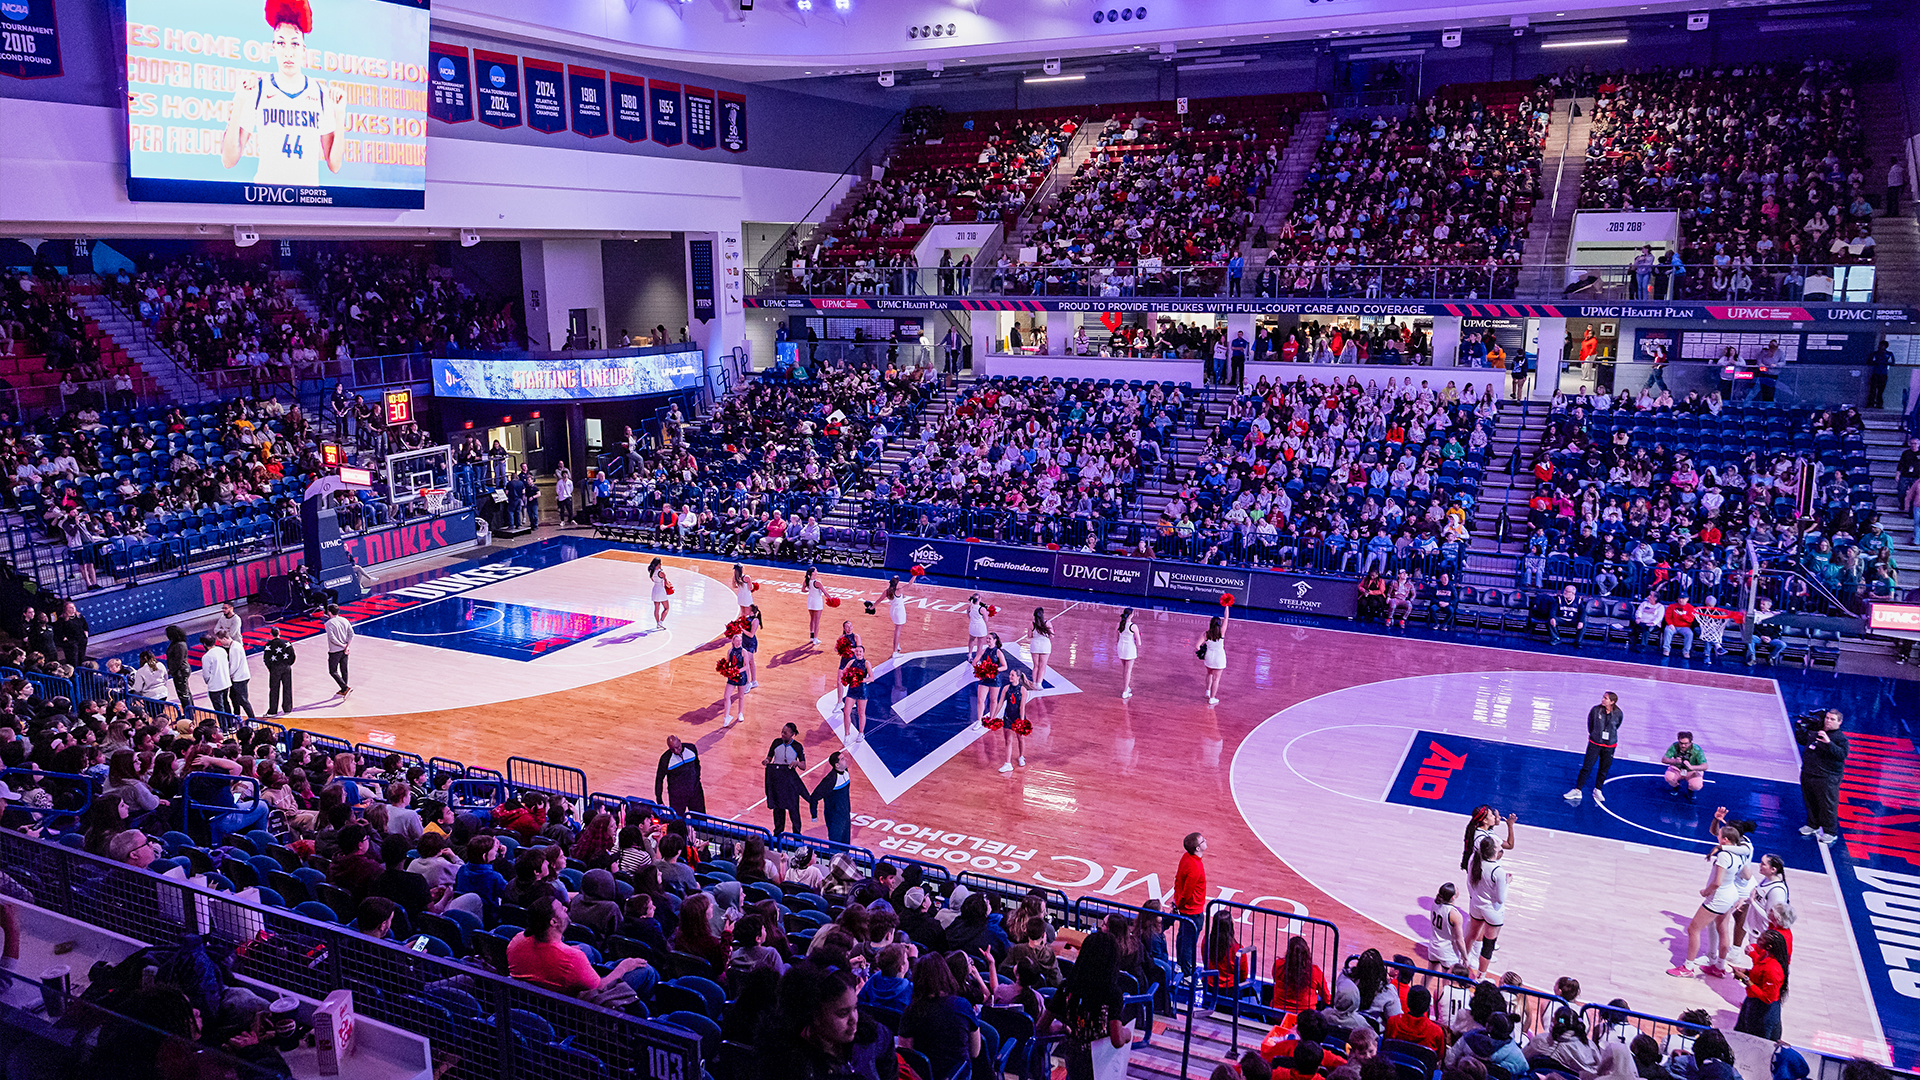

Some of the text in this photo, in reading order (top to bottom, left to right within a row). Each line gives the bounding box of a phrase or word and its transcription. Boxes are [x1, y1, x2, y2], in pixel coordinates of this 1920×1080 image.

[1, 2, 29, 15] NCAA
[1, 22, 54, 35] TOURNAMENT
[2, 31, 37, 54] 2016
[24, 56, 52, 65] ROUND
[164, 27, 242, 60] HOME
[324, 50, 390, 79] DUKES
[535, 80, 556, 98] 2024
[581, 86, 597, 104] 1981
[490, 95, 510, 111] 2024
[621, 93, 638, 110] 1980
[659, 98, 674, 114] 1955
[344, 112, 391, 136] UKES
[281, 134, 303, 159] 44
[244, 186, 295, 203] UPMC
[300, 189, 327, 197] SPORTS
[300, 196, 333, 205] MEDICINE
[1609, 221, 1642, 232] 209 208
[74, 245, 89, 257] 214
[763, 299, 787, 308] UPMC
[822, 300, 847, 309] UPMC
[876, 300, 948, 310] UPMC HEALTH PLAN
[1058, 302, 1427, 315] PROUD TO PROVIDE THE DUKES WITH FULL-COURT CARE AND COVERAGE.
[1580, 306, 1694, 318] UPMC HEALTH PLAN
[1727, 308, 1769, 319] UPMC
[1827, 309, 1872, 320] UPMC
[1463, 319, 1492, 328] UPMC
[512, 366, 635, 390] STARTING LINEUPS
[388, 392, 408, 404] 10:00
[390, 402, 406, 421] 30
[326, 453, 336, 463] 30
[320, 538, 343, 550] UPMC
[199, 519, 448, 607] DUQUEE DUKES
[982, 559, 1050, 574] DeanHonda.com
[1062, 563, 1109, 581] UPMC
[1112, 575, 1132, 584] PLAN
[1113, 568, 1141, 578] HEALTH
[1170, 572, 1245, 587] SCHNEIDER DOWNS
[387, 562, 534, 600] DUKES
[754, 577, 866, 596] FIELOUSE
[776, 586, 854, 601] COER
[1278, 598, 1322, 608] STEELPOINT
[1873, 610, 1920, 625] UPMC
[1409, 740, 1469, 801] A10
[878, 834, 1022, 875] COOPER
[1431, 910, 1443, 931] 20
[646, 1045, 684, 1080] 103
